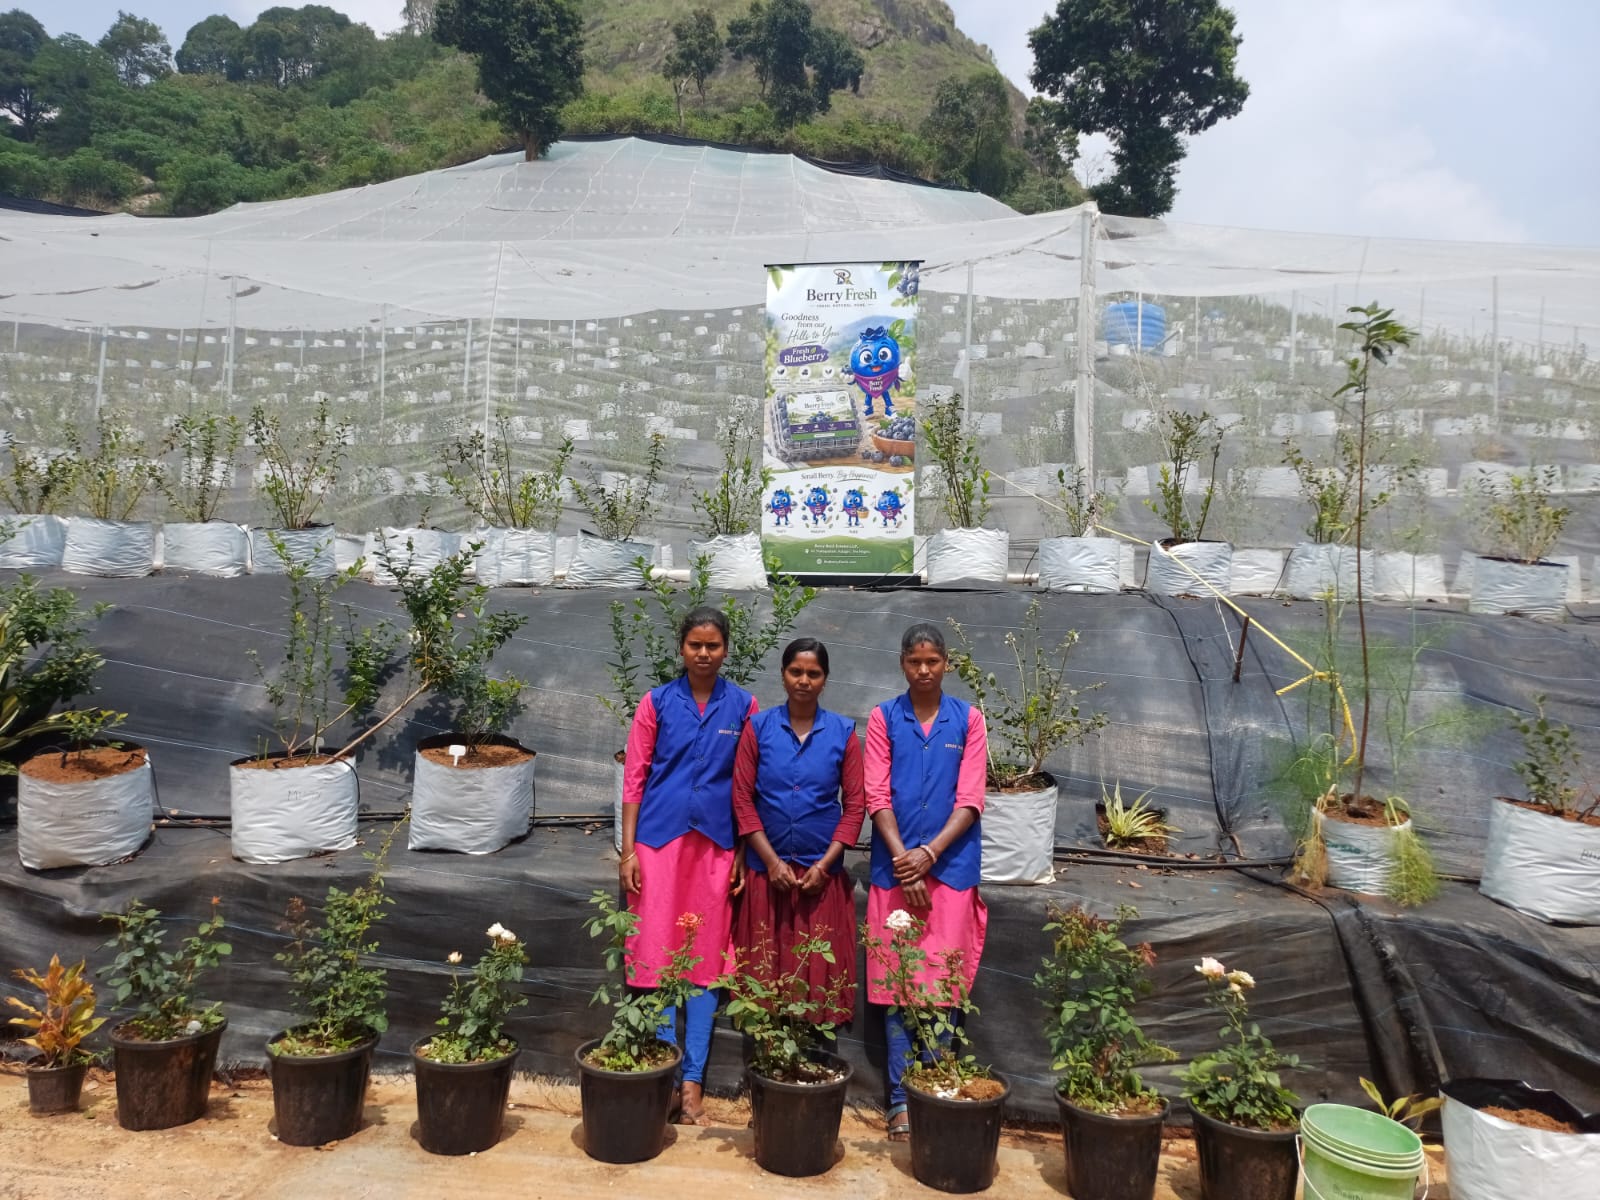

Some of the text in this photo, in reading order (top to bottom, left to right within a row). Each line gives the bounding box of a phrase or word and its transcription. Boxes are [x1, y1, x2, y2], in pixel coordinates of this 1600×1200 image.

[807, 288, 877, 303] Berry Fresh
[781, 313, 819, 321] Goodness
[784, 353, 826, 364] Blueberry
